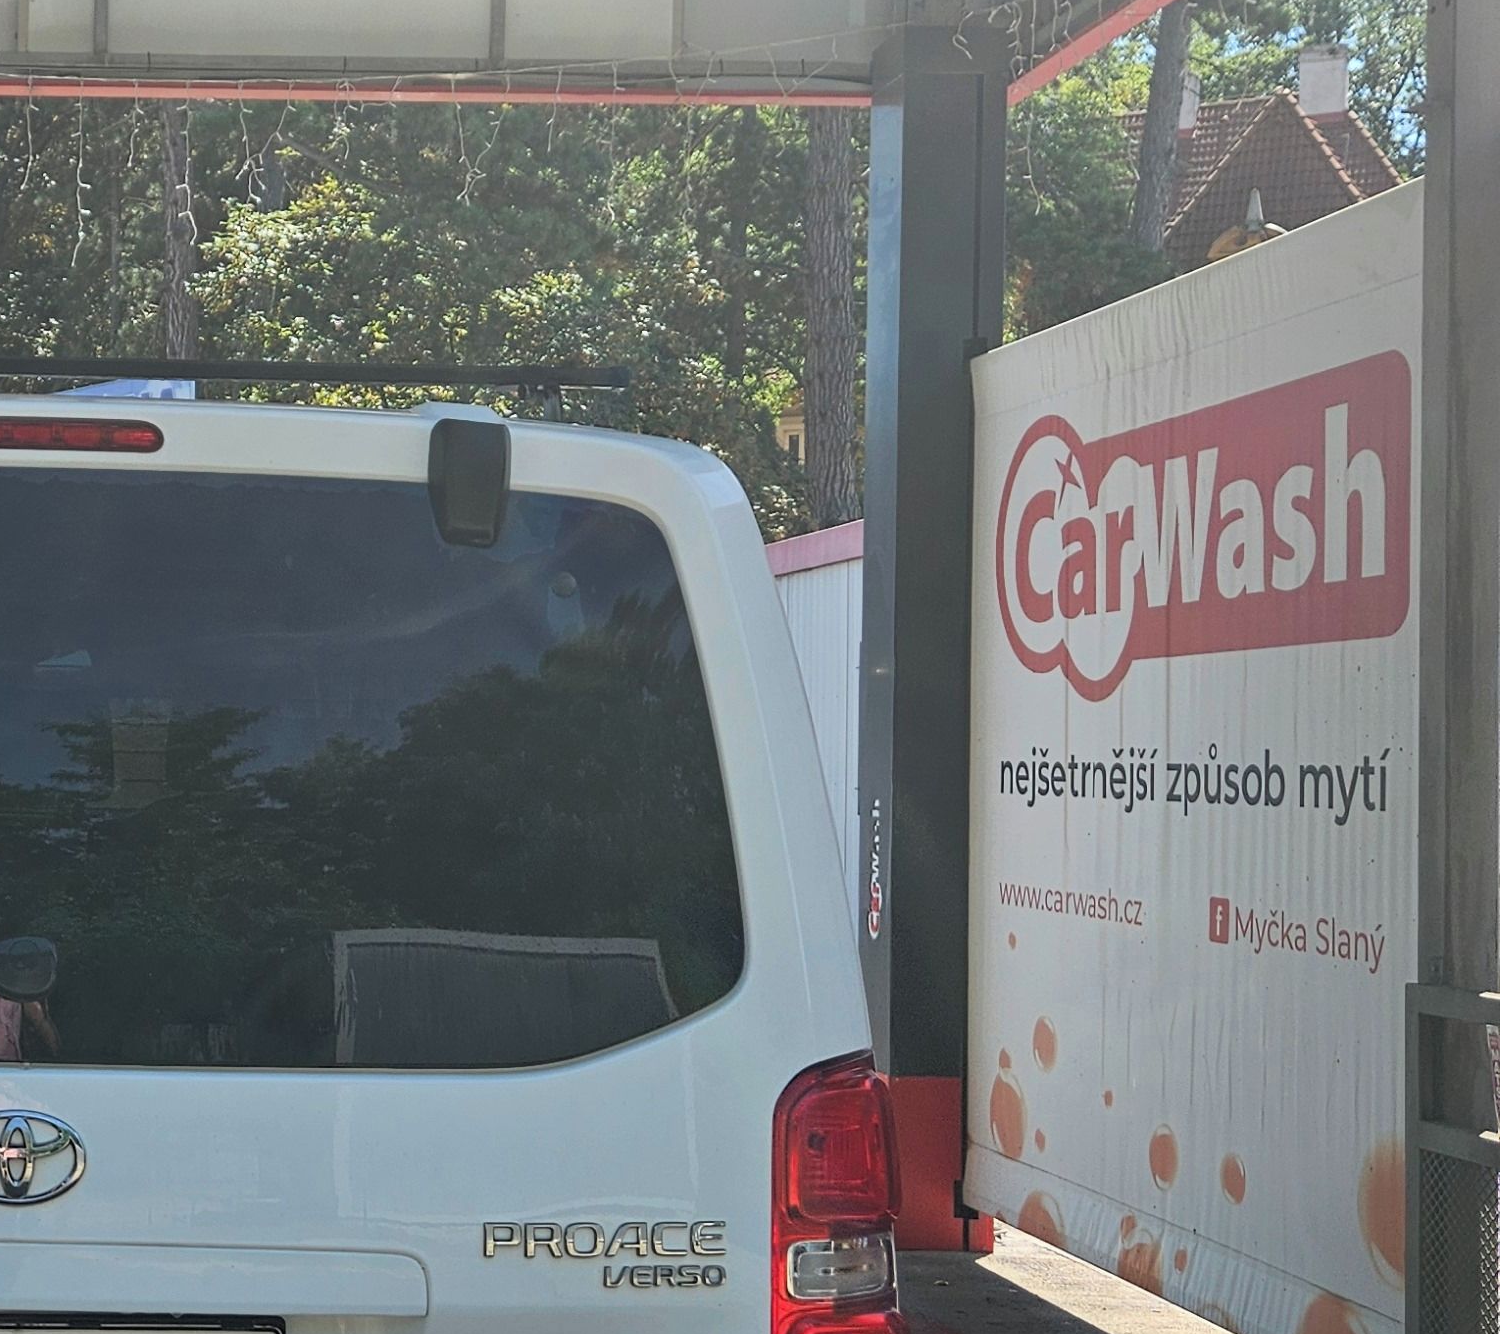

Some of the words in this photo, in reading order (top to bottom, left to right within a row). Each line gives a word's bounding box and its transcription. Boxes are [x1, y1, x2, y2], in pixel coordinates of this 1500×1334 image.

[1008, 403, 1387, 635] CarWash
[1000, 746, 1158, 814] nejšetrnější
[1166, 743, 1286, 817] způsob
[1299, 748, 1391, 827] mytí
[999, 881, 1144, 927] www.carwash.cz
[1234, 906, 1307, 954] Myčka
[1315, 917, 1386, 975] Slaný
[483, 1220, 727, 1259] PROACE
[603, 1264, 727, 1288] VERSO
